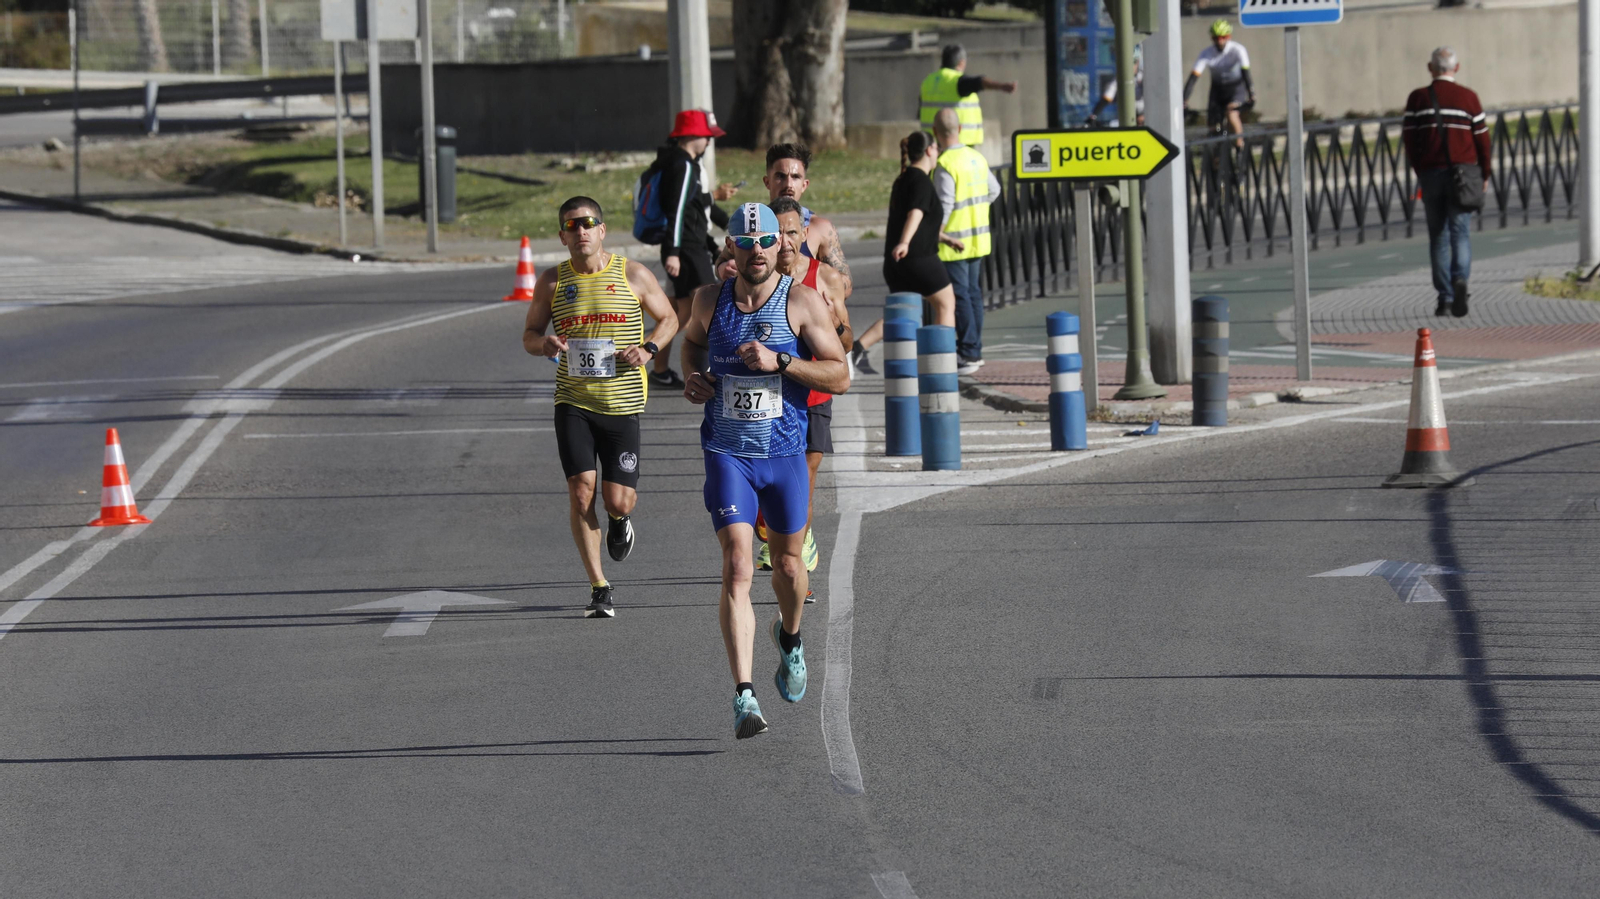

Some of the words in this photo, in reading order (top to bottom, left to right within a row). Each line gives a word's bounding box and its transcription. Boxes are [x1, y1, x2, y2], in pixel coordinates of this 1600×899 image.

[1059, 142, 1141, 167] puerto
[560, 313, 627, 330] ESTEPONA
[579, 352, 595, 368] 36
[725, 356, 744, 364] Atleti
[733, 391, 763, 410] 237
